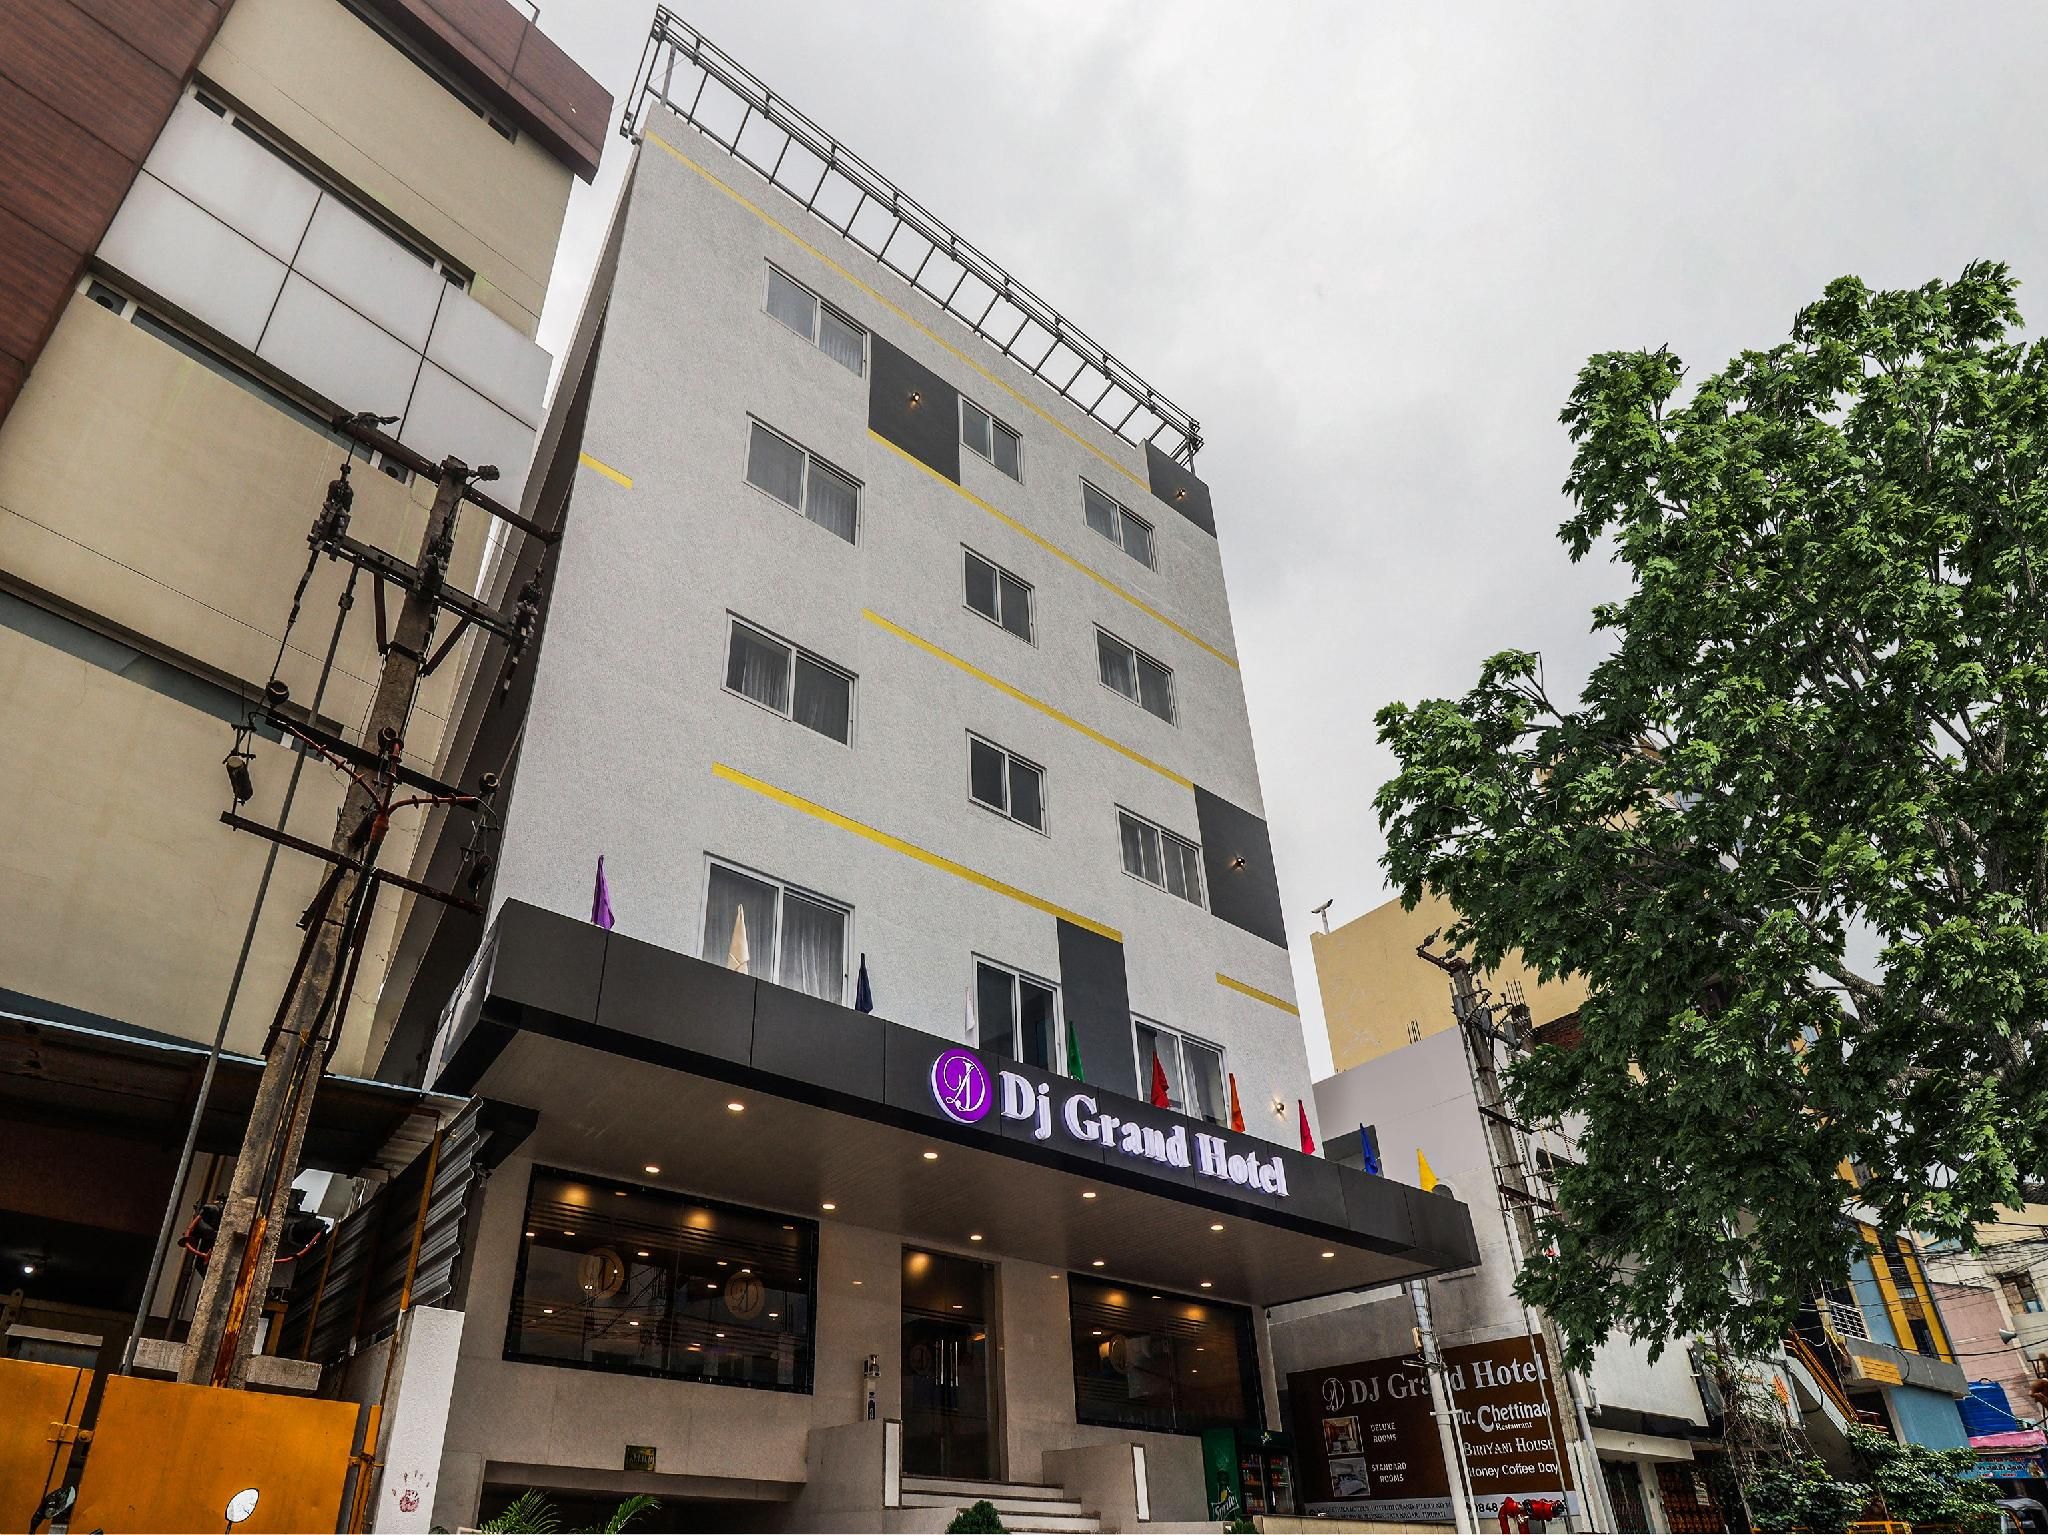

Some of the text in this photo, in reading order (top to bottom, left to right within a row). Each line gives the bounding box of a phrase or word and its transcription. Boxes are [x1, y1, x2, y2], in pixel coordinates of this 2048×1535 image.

[999, 1070, 1289, 1197] Dj Grand Hotel
[1350, 1353, 1548, 1405] DJ Grd Hotel
[1370, 1422, 1396, 1432] DELUXE
[1496, 1421, 1533, 1431] Restaurant
[1373, 1434, 1397, 1443] ROOMS
[1371, 1462, 1407, 1472] STANDARD
[1502, 1463, 1535, 1475] Coffee
[1538, 1462, 1558, 1476] Day
[1379, 1473, 1404, 1483] ROOMS
